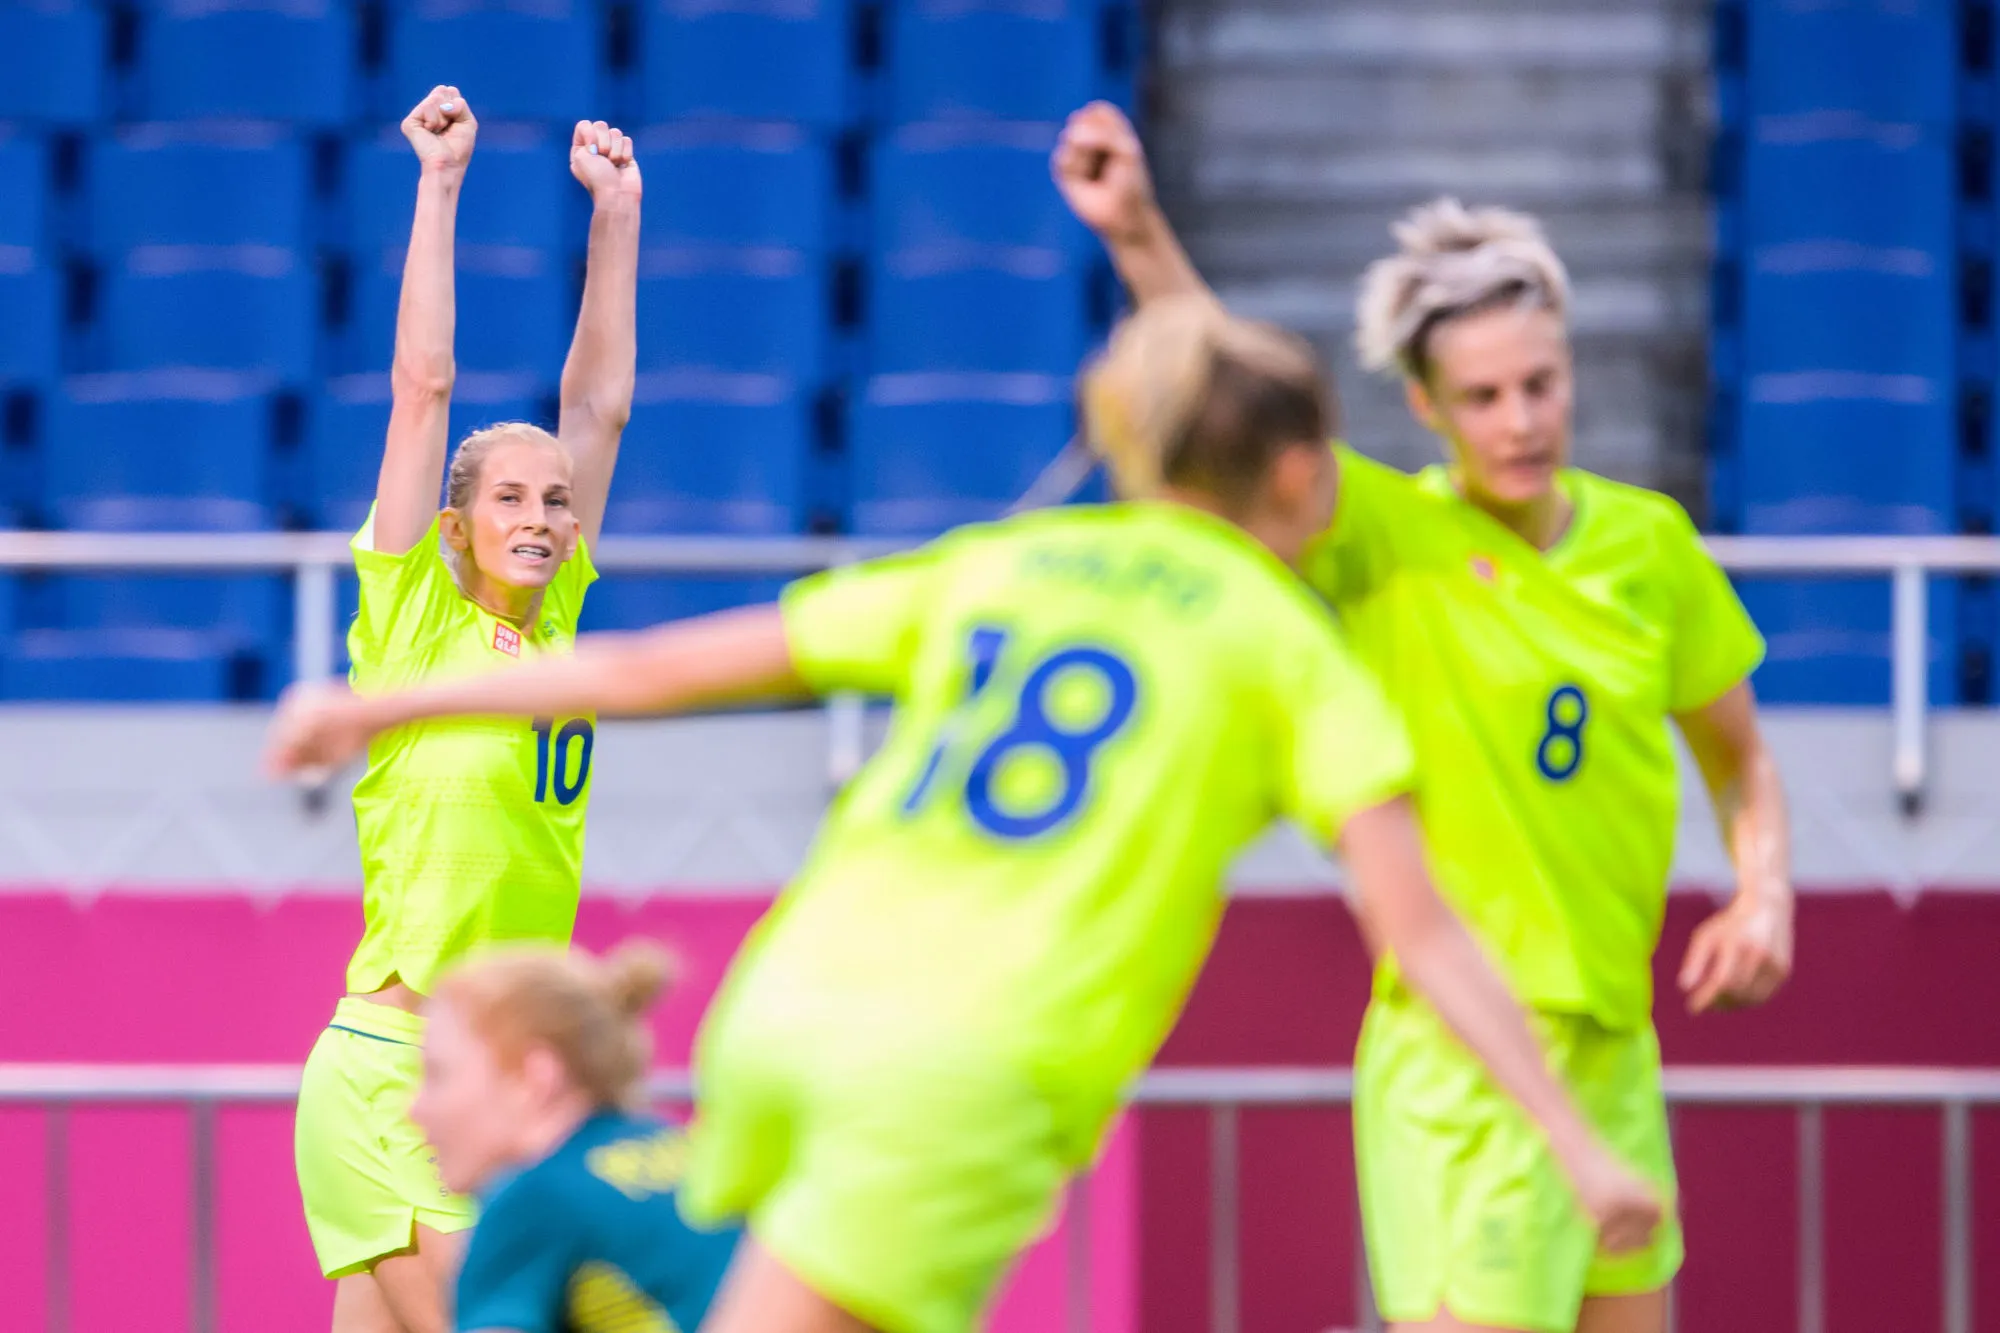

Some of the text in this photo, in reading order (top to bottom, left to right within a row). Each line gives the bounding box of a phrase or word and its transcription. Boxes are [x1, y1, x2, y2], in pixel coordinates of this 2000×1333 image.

[495, 637, 519, 656] QLO
[497, 625, 518, 645] UNI
[532, 712, 594, 806] 10
[902, 627, 1137, 840] 18
[1536, 684, 1588, 782] 8
